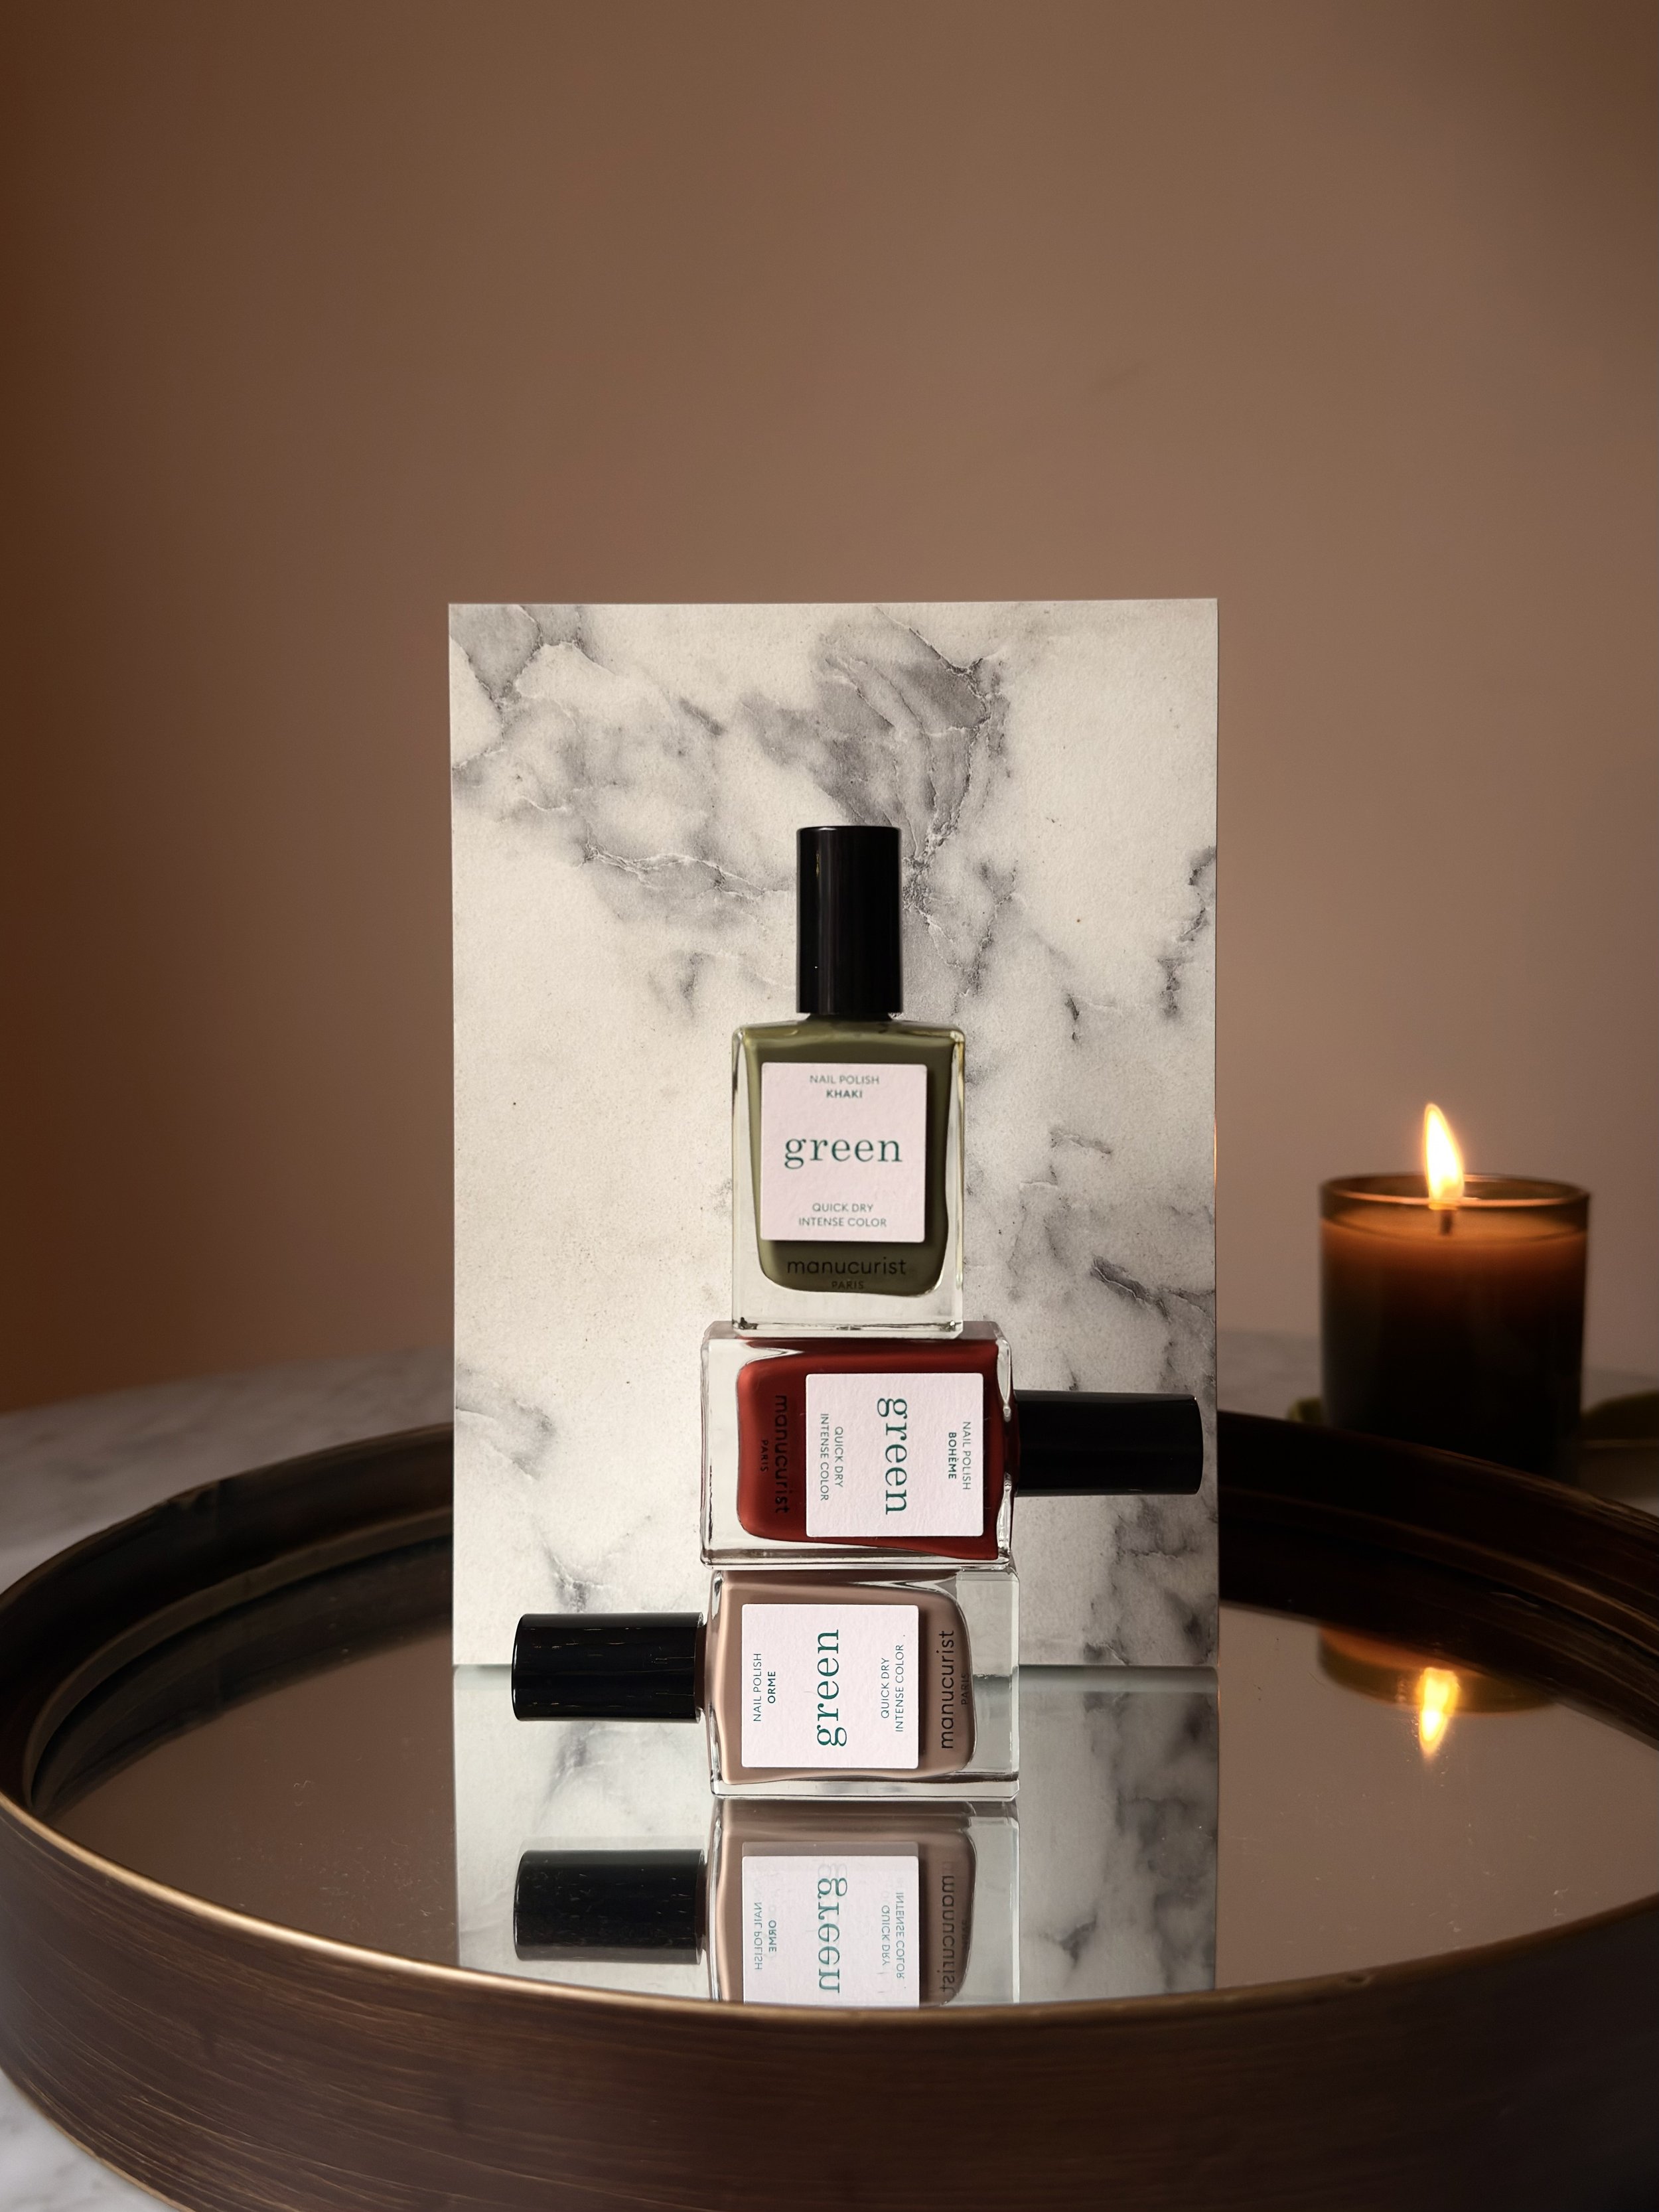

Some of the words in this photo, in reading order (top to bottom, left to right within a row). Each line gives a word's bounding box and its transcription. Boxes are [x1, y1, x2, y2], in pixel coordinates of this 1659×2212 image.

[810, 1074, 835, 1084] NAIL
[839, 1075, 879, 1084] POLISH
[826, 1090, 863, 1099] KHAKI
[784, 1138, 902, 1169] green
[798, 1217, 844, 1226] INTENSE
[847, 1218, 887, 1227] COLOR
[812, 1203, 849, 1213] QUICK
[787, 1257, 906, 1275] manucurist
[831, 1281, 865, 1290] PARIS
[820, 1413, 830, 1459] INTENSE
[835, 1426, 843, 1463] QUICK
[775, 1395, 793, 1514] manucurist
[877, 1398, 908, 1515] green
[820, 1461, 830, 1501] COLOR
[835, 1465, 843, 1487] DRY
[881, 1657, 890, 1679] DRY
[895, 1645, 904, 1684] COLOR
[816, 1629, 847, 1747] green
[881, 1682, 890, 1719] QUICK
[936, 1631, 954, 1749] manucurist
[961, 1673, 970, 1705] PARIS
[753, 1696, 762, 1722] NAIL
[895, 1686, 904, 1732] INTENSE
